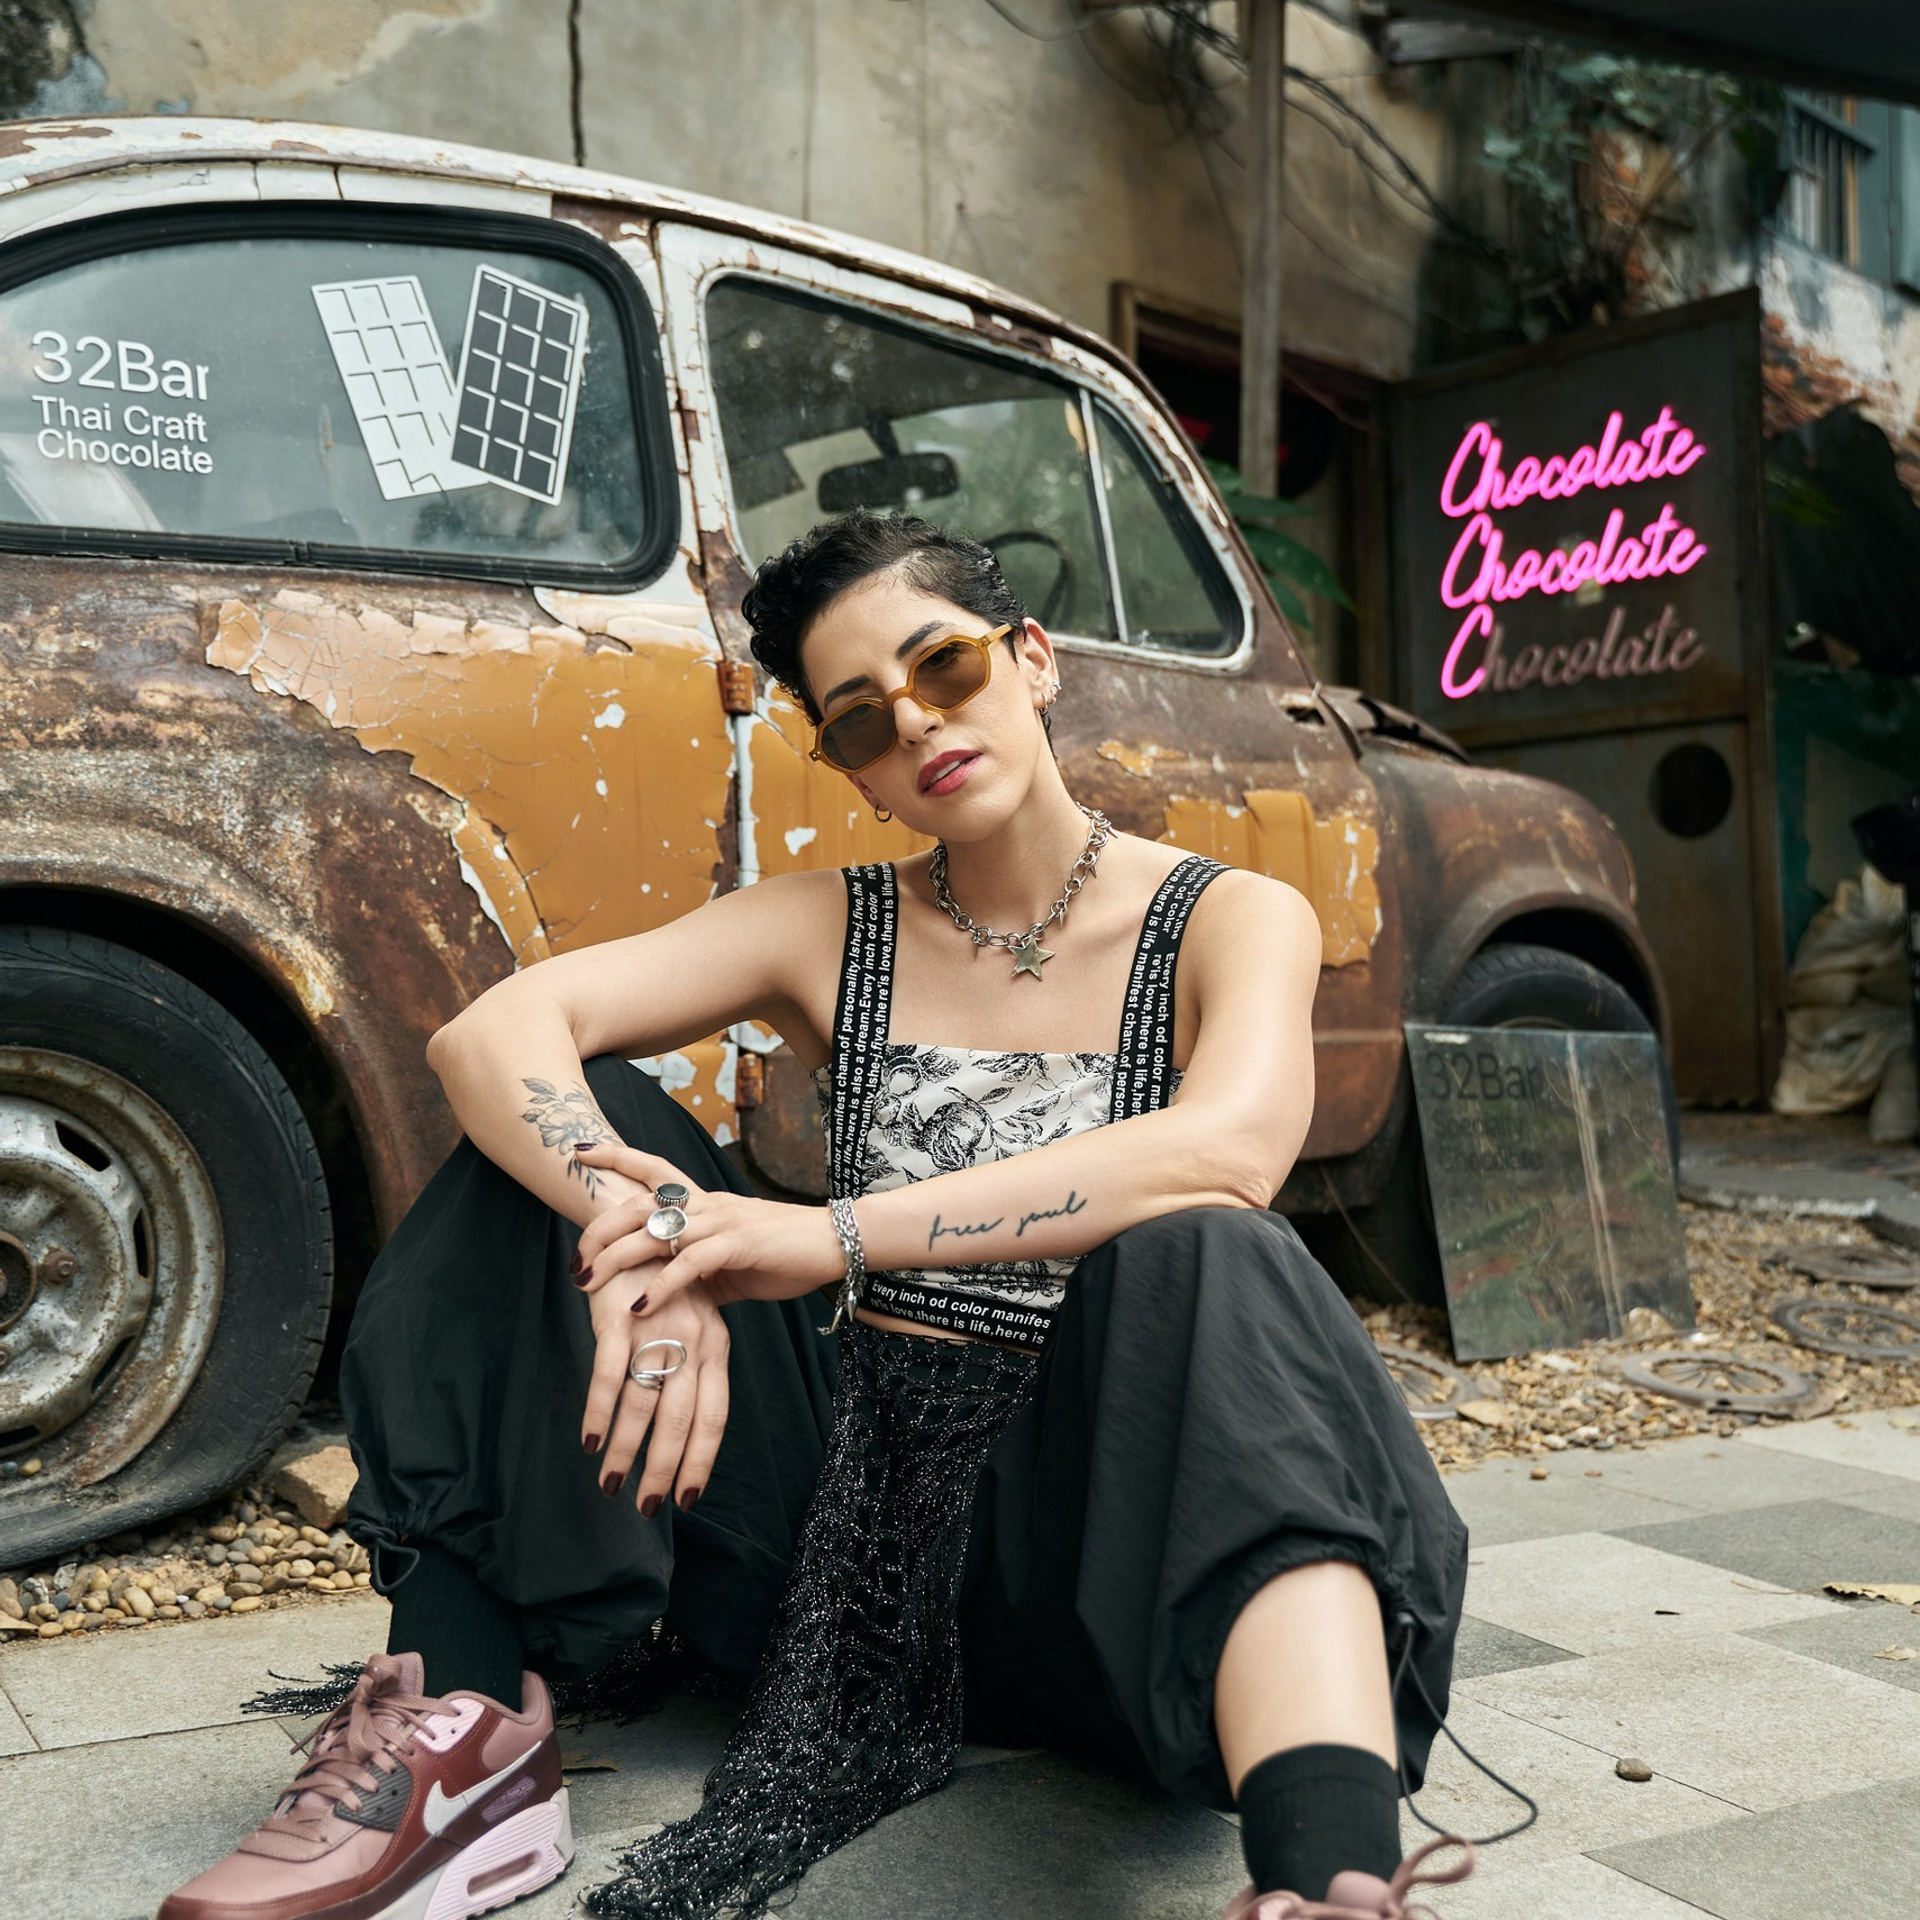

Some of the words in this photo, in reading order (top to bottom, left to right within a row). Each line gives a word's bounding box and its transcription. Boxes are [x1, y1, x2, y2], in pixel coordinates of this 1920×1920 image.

[31, 330, 209, 400] 32Bar
[31, 394, 112, 431] Thai
[123, 405, 208, 442] Craft
[37, 428, 213, 474] Chocolate
[1440, 404, 1706, 518] Chocolate
[1440, 502, 1707, 608] Chocolate
[1440, 603, 1705, 698] Chocolate
[867, 892, 878, 920] color
[882, 899, 894, 909] is
[1174, 886, 1187, 899] od
[866, 922, 877, 939] od
[1148, 915, 1162, 927] is
[1162, 902, 1178, 933] color
[1142, 930, 1158, 949] life
[862, 943, 876, 970] inch
[1159, 952, 1175, 989] Every
[1127, 952, 1148, 1008] manifest
[1157, 993, 1170, 1022] inch
[1155, 1026, 1168, 1043] od
[856, 1056, 865, 1064] a
[1136, 1054, 1150, 1065] is
[1152, 1047, 1166, 1082] color
[851, 1067, 864, 1094] also
[834, 1091, 846, 1145] manifest
[848, 1098, 860, 1109] is
[833, 1146, 842, 1179] color
[928, 1214, 1004, 1252] free
[1016, 1190, 1087, 1237] soul
[872, 1280, 897, 1301] Every
[899, 1288, 925, 1305] inch
[929, 1296, 948, 1309] od
[951, 1301, 989, 1316] color
[991, 1309, 1051, 1329] manifes
[954, 1316, 965, 1329] is
[1032, 1331, 1045, 1344] is
